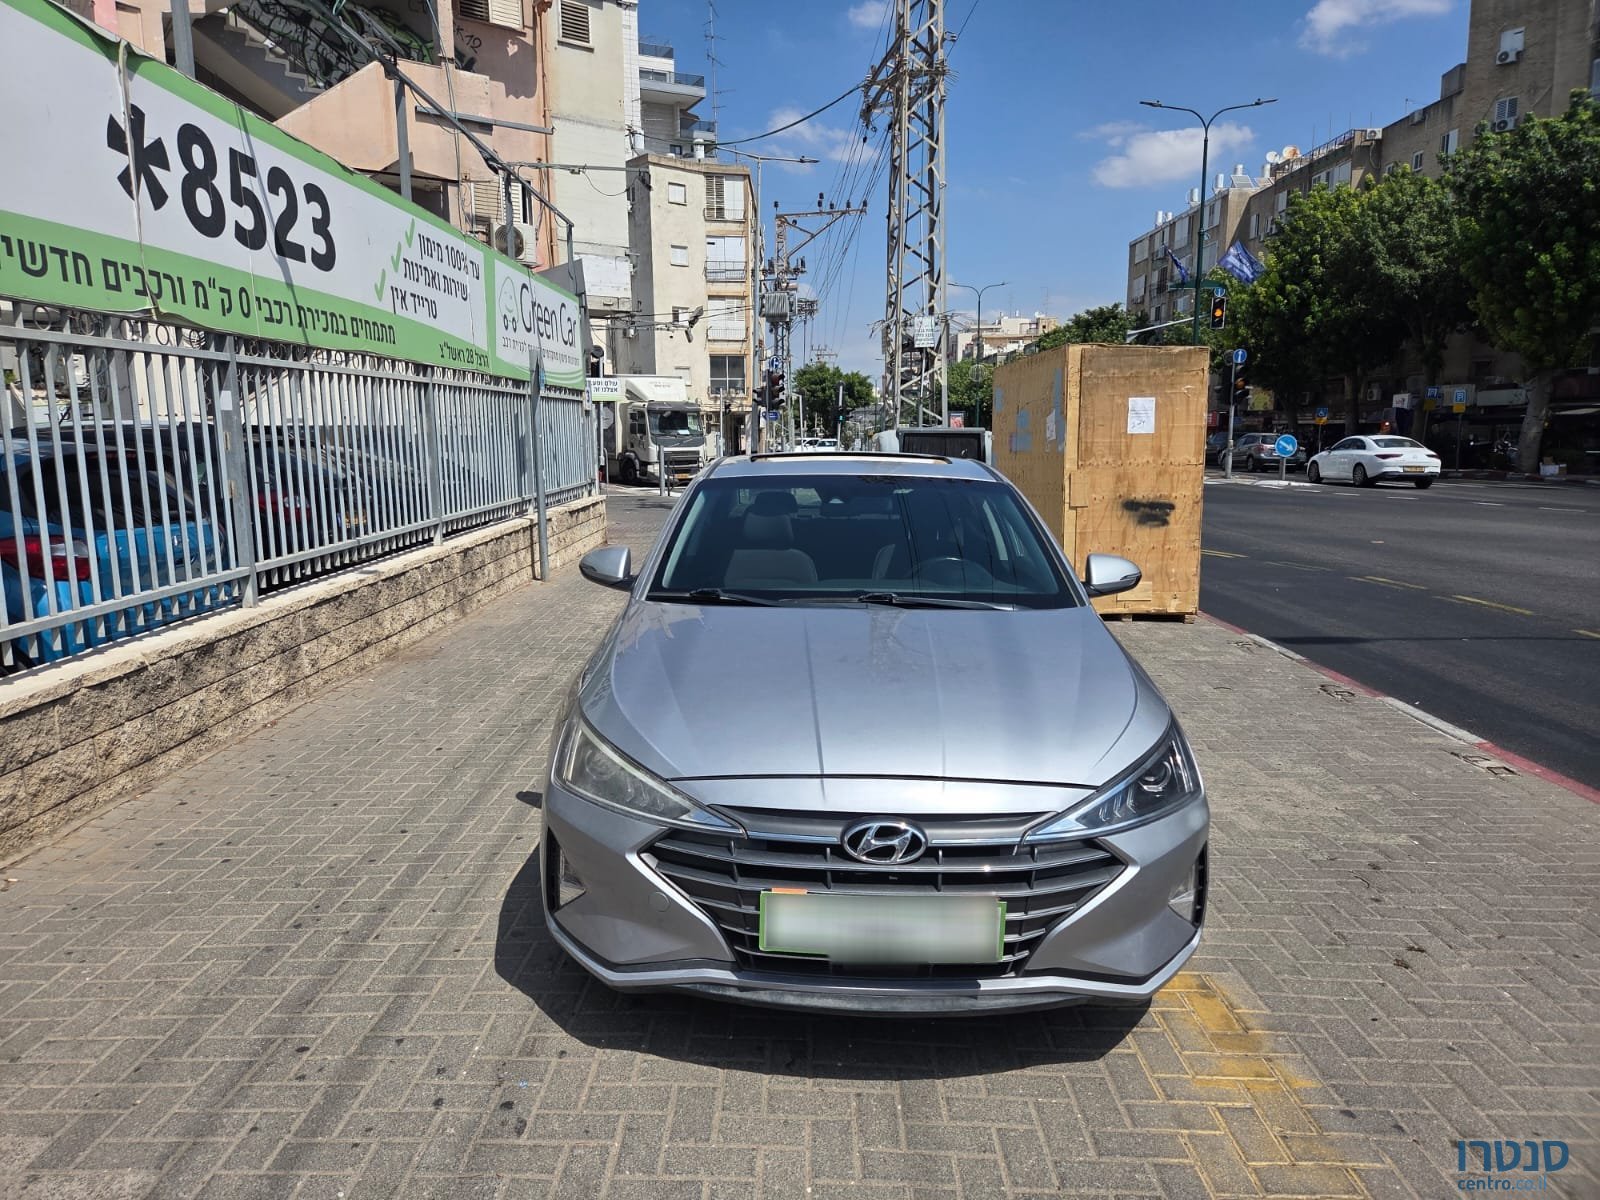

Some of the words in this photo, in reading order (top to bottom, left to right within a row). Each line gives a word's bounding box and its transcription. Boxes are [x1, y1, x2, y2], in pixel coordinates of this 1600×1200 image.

[0, 234, 93, 288] חדשי
[418, 233, 443, 263] מימון
[445, 244, 469, 275] 100%
[101, 258, 187, 306] ורכבים
[403, 257, 441, 291] ואמינות
[469, 260, 480, 281] עד
[239, 286, 251, 318] 0
[390, 285, 408, 315] אין
[443, 275, 468, 301] שירות
[255, 296, 293, 326] רכבי
[296, 304, 348, 336] במכירת
[410, 292, 438, 319] טרייד
[520, 282, 559, 342] Green
[560, 302, 577, 348] Car
[350, 316, 396, 345] מתמחים
[466, 347, 475, 365] 28
